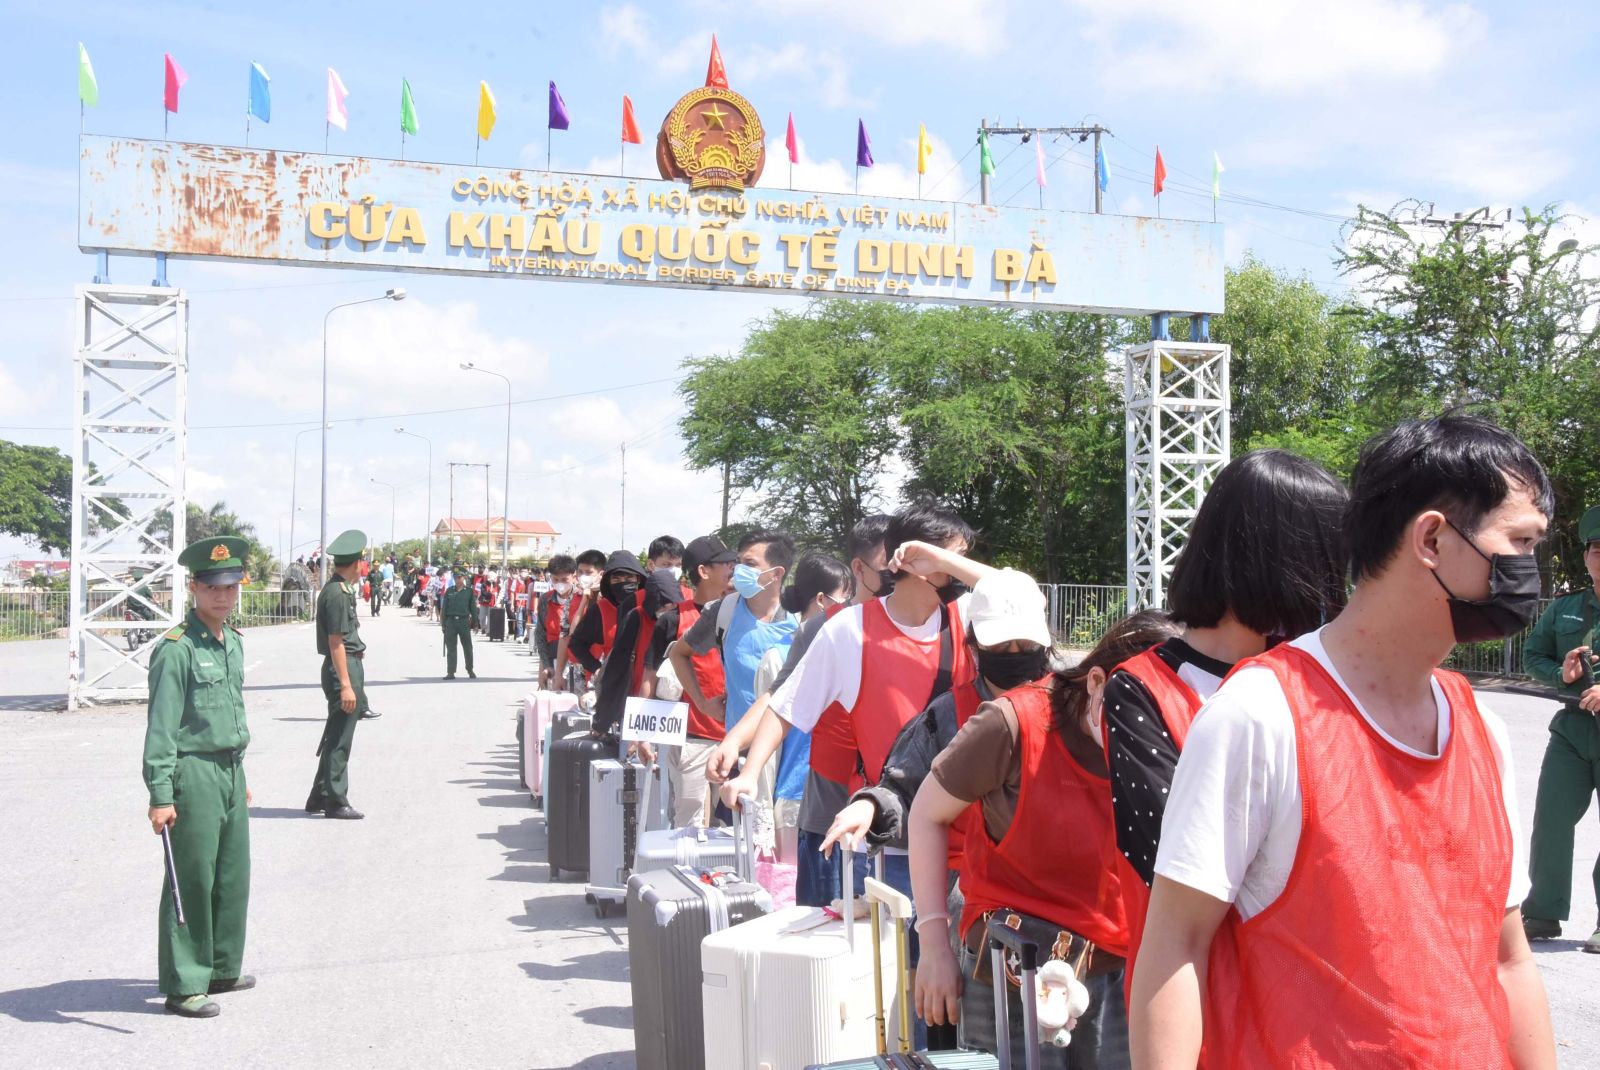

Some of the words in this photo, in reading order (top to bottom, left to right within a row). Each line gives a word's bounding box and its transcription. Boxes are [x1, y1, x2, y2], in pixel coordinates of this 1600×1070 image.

[454, 176, 528, 200] CỘNG
[603, 187, 639, 207] XÃ
[649, 188, 691, 213] HỘI
[699, 193, 748, 214] CHỦ
[757, 199, 829, 220] NGHĨA
[838, 204, 888, 225] VIỆT
[899, 209, 949, 229] NAM
[310, 194, 427, 244] CỬA
[450, 204, 601, 255] KHẨU
[621, 220, 760, 265] QUỐC
[780, 226, 841, 270] TẾ
[858, 239, 974, 278] DINH
[994, 243, 1057, 284] BÀ
[491, 255, 648, 276] INTERNATIONAL
[658, 265, 737, 281] BORDER
[745, 271, 794, 284] GATE
[803, 274, 828, 286] OF
[836, 276, 879, 288] DINH
[887, 279, 911, 291] BA
[628, 713, 657, 735] LẠNG
[659, 716, 682, 734] SƠN
